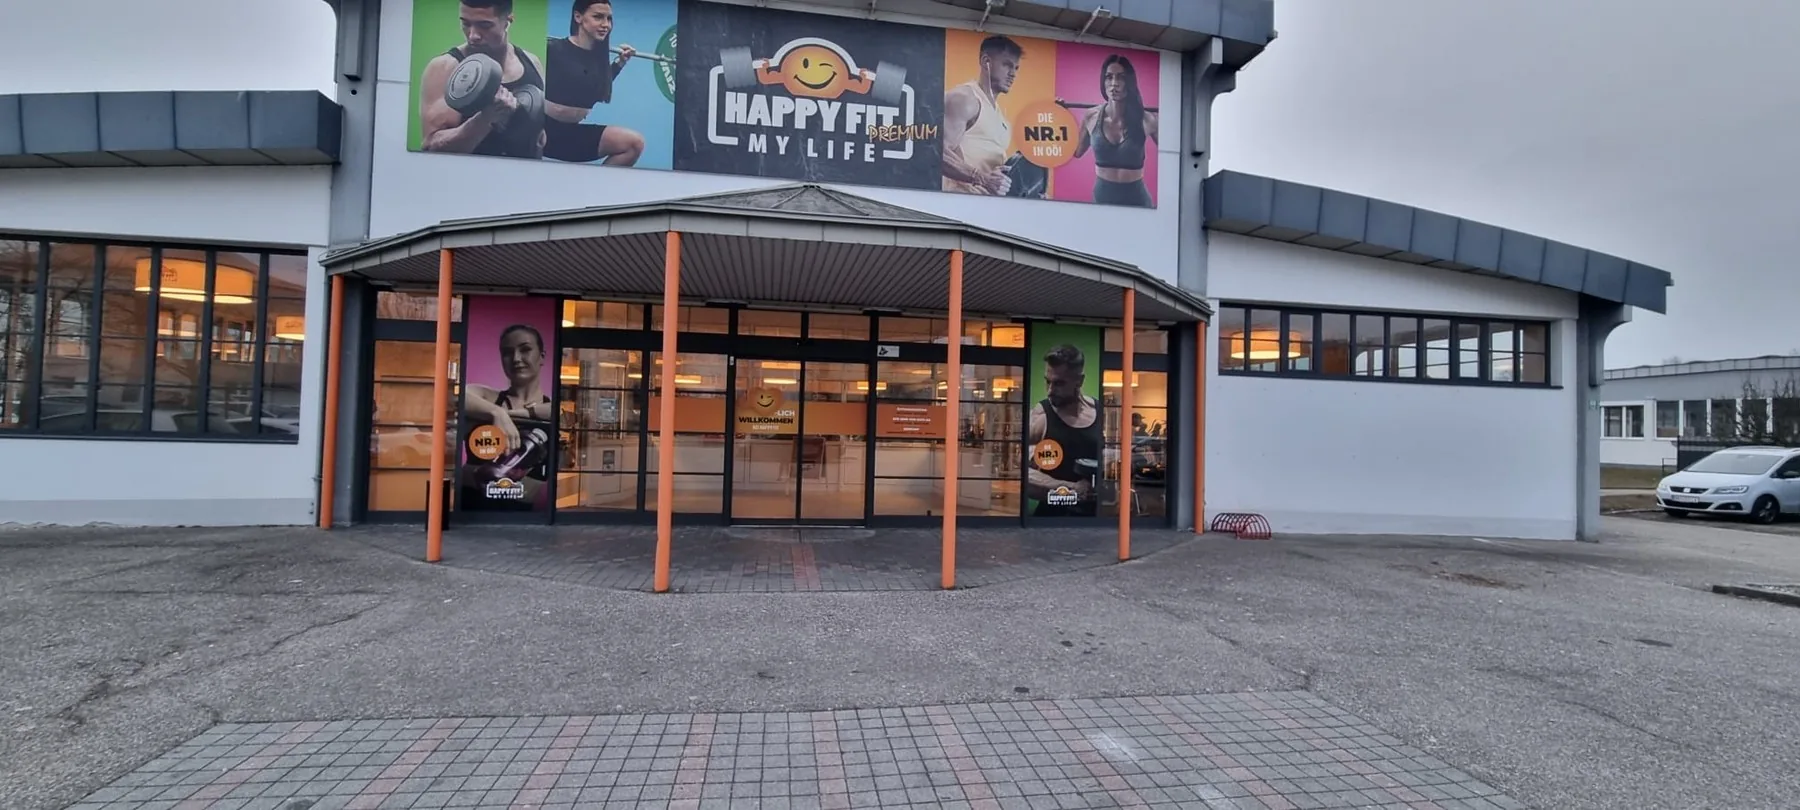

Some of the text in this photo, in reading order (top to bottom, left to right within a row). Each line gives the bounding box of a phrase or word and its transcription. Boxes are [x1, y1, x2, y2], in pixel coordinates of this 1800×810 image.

[725, 91, 900, 136] HAPPY FIT
[1038, 112, 1054, 123] DIE
[868, 124, 938, 142] PREMIUM
[1024, 126, 1068, 141] NR.1
[748, 133, 876, 162] MY LIFE
[1033, 144, 1062, 157] IN OÖ!
[738, 416, 794, 425] WILLKOMMEN
[475, 437, 500, 447] NR.1
[1037, 450, 1059, 459] NR.1
